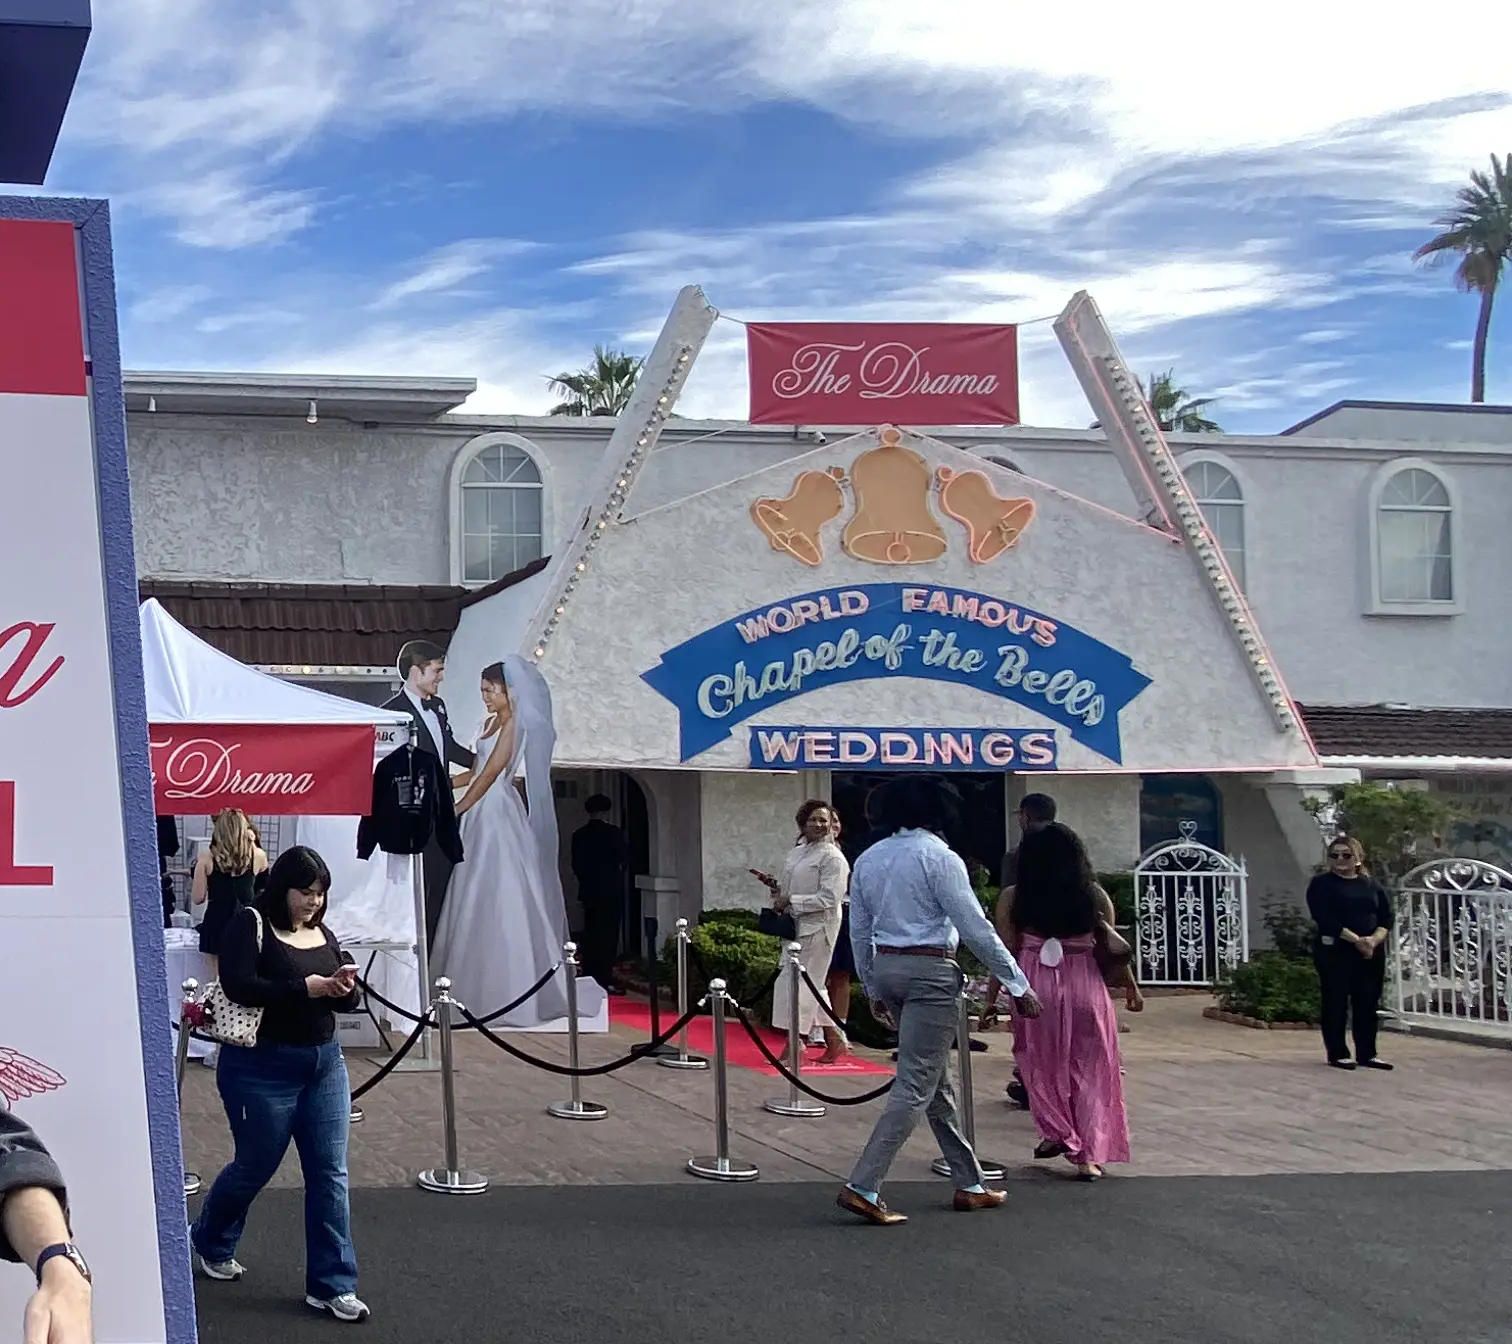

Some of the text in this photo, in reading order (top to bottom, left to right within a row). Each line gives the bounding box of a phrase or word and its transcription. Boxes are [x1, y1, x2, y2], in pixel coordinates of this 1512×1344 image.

[772, 341, 999, 399] The Drama
[736, 588, 1058, 647] WORLD FAMOUS
[697, 623, 1106, 726] Chapel of the Bells
[165, 738, 316, 799] Drama
[757, 730, 1055, 765] WEDDINGS
